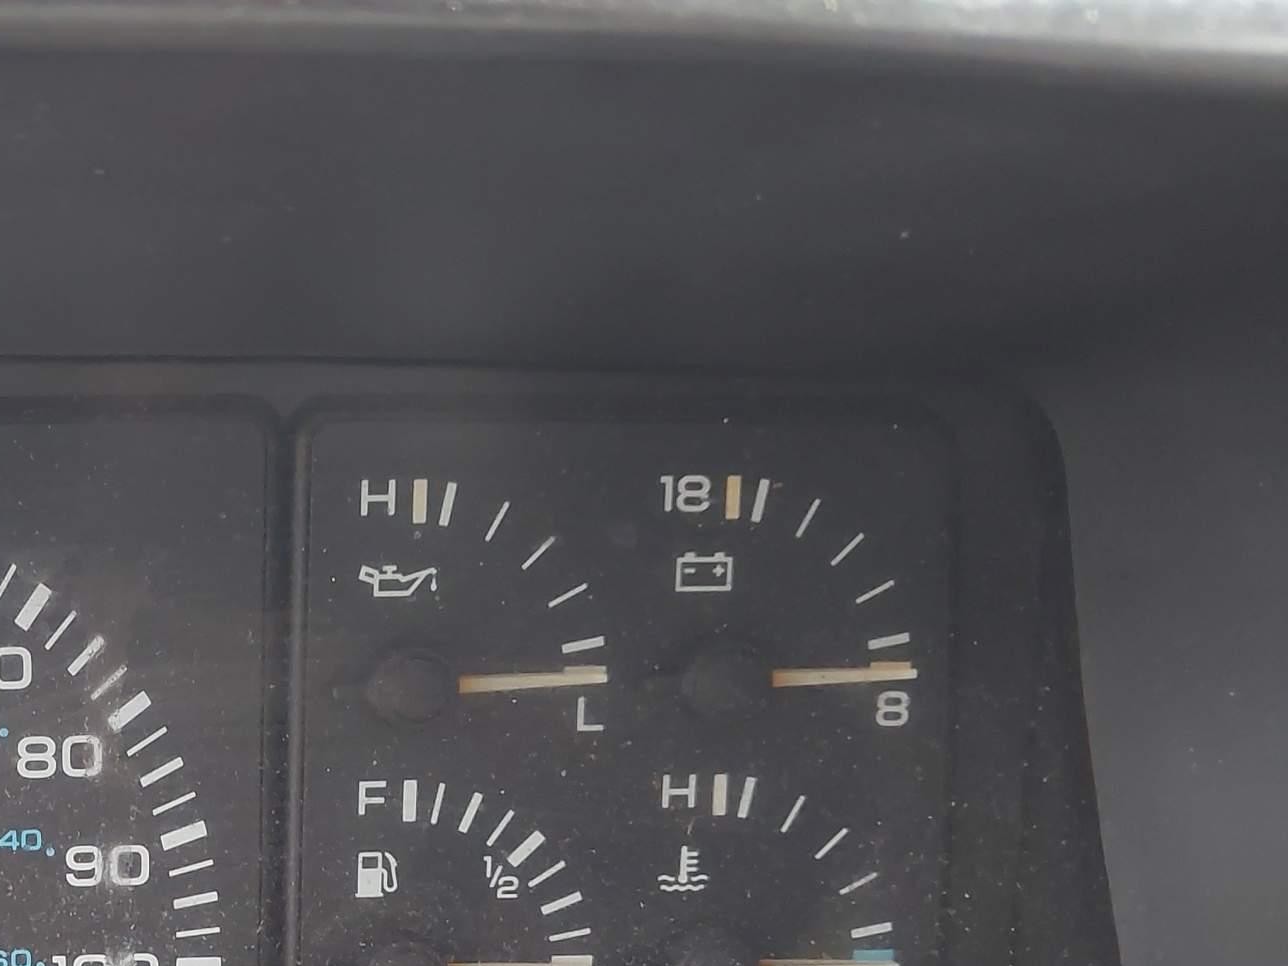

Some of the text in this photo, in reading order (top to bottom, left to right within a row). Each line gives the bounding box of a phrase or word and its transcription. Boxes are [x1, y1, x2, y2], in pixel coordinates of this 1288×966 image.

[360, 479, 396, 516] H
[660, 475, 711, 512] 18
[577, 696, 604, 732] L
[875, 690, 910, 727] 8
[16, 735, 102, 779] 80
[358, 781, 387, 815] F
[662, 774, 696, 808] H
[66, 845, 150, 887] 90
